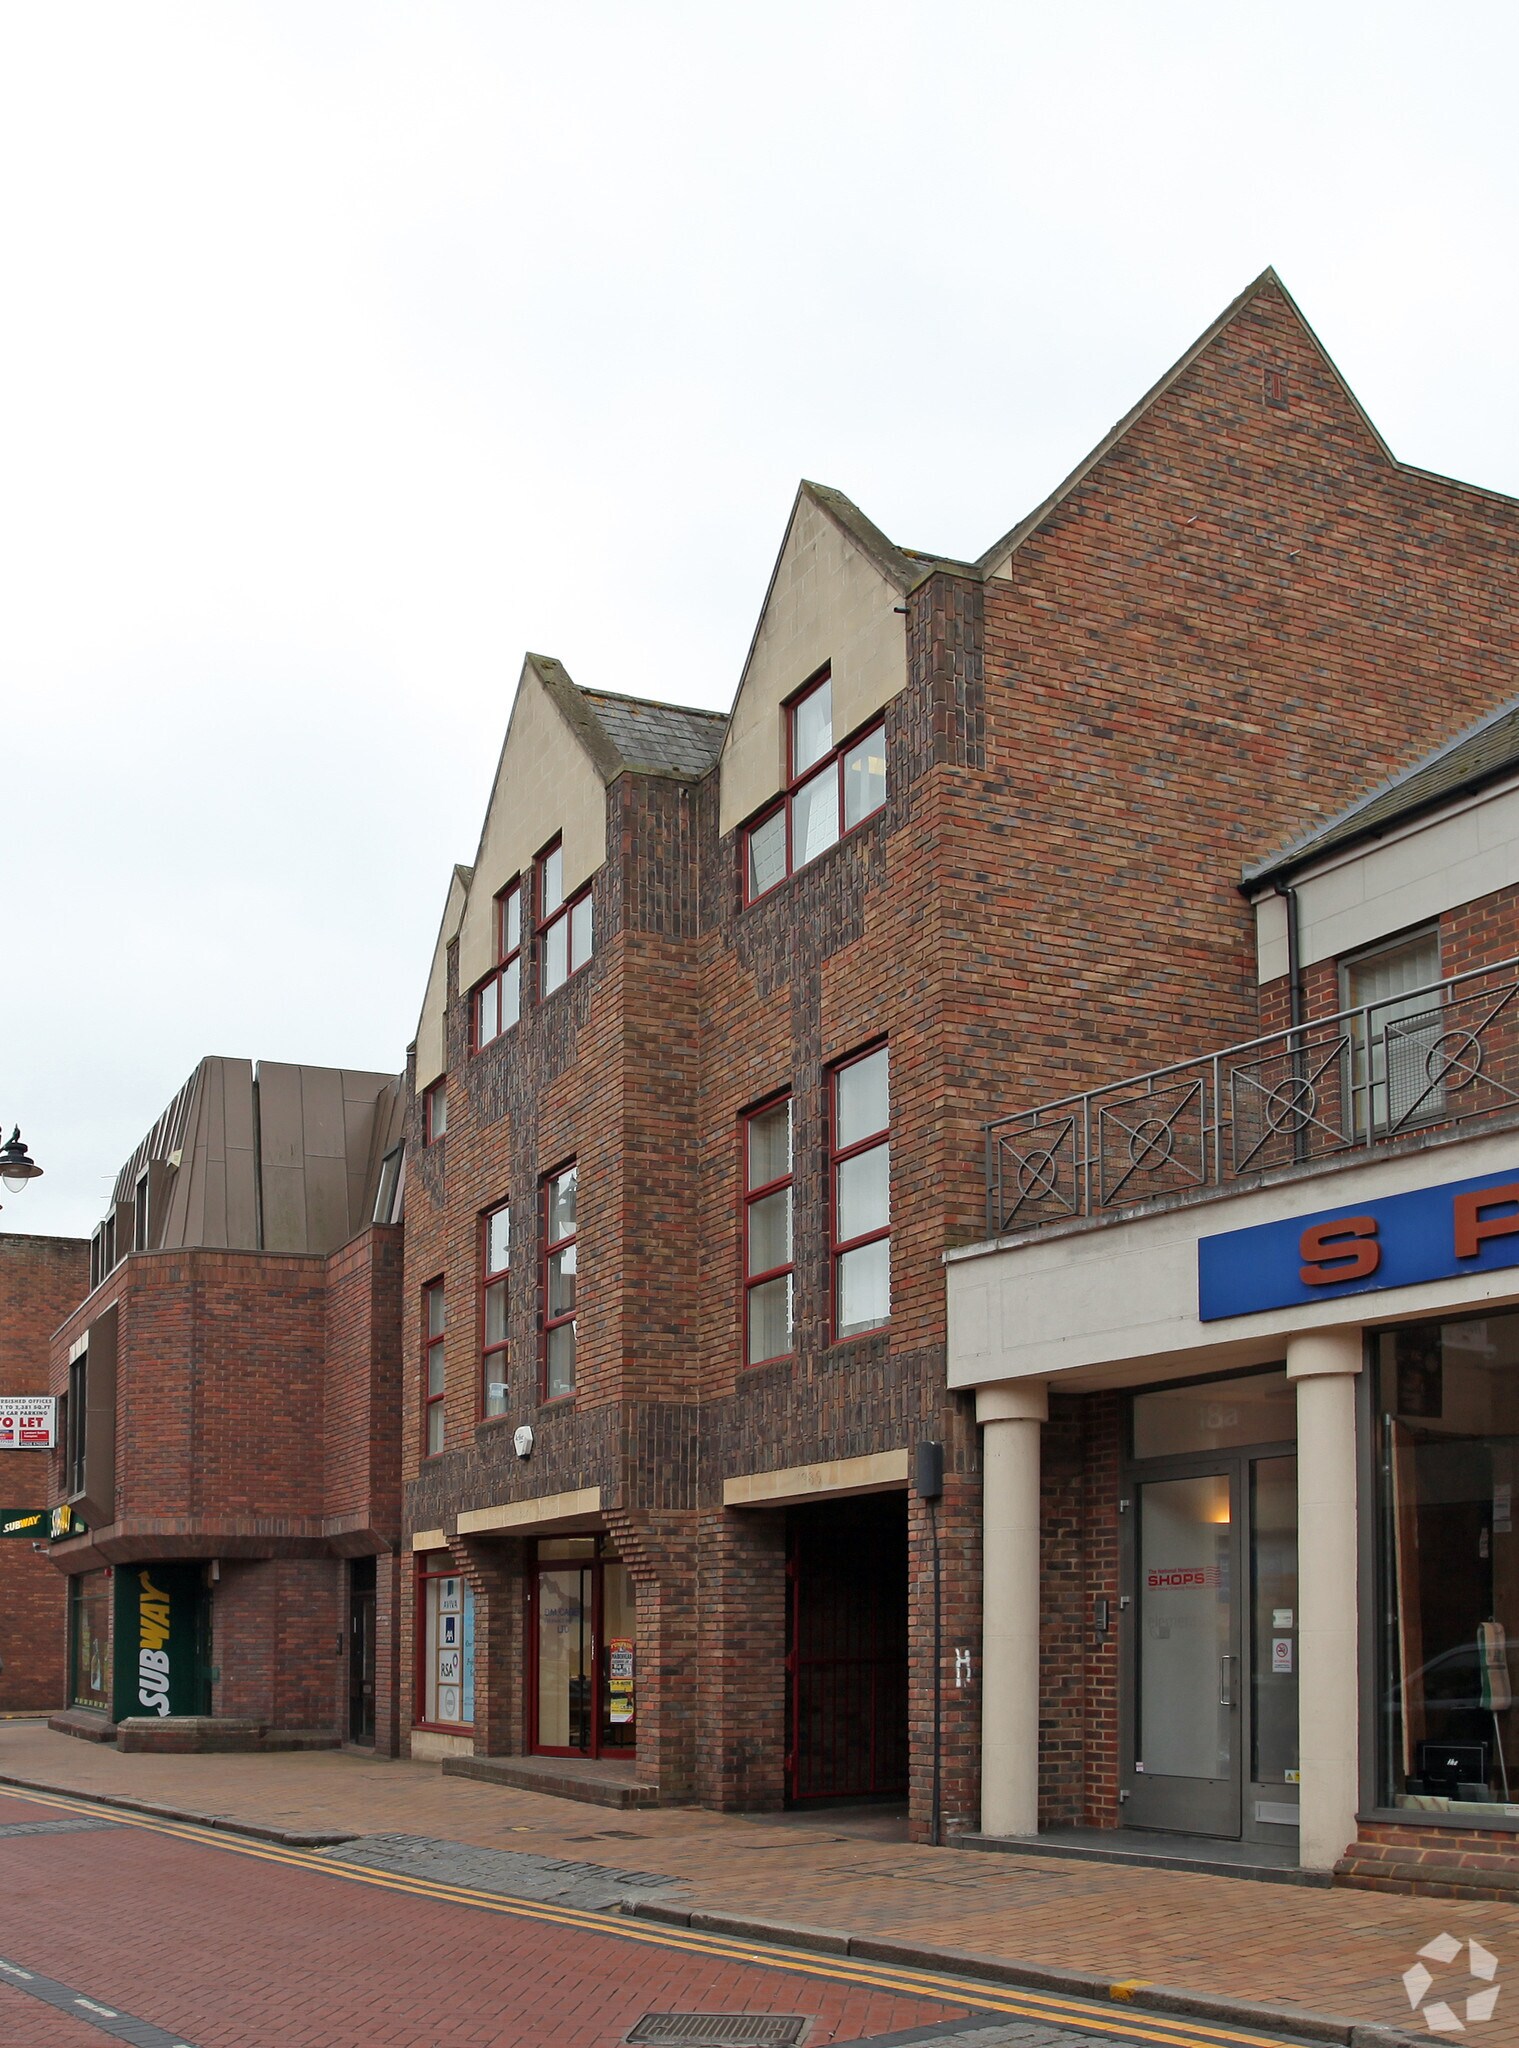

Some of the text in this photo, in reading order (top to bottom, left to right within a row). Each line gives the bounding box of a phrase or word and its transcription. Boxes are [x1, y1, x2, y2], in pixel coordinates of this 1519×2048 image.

[19, 1417, 44, 1428] LET
[2, 1514, 42, 1533] SUBWAY
[138, 1570, 171, 1717] SUBWAY
[441, 1663, 454, 1677] RSA
